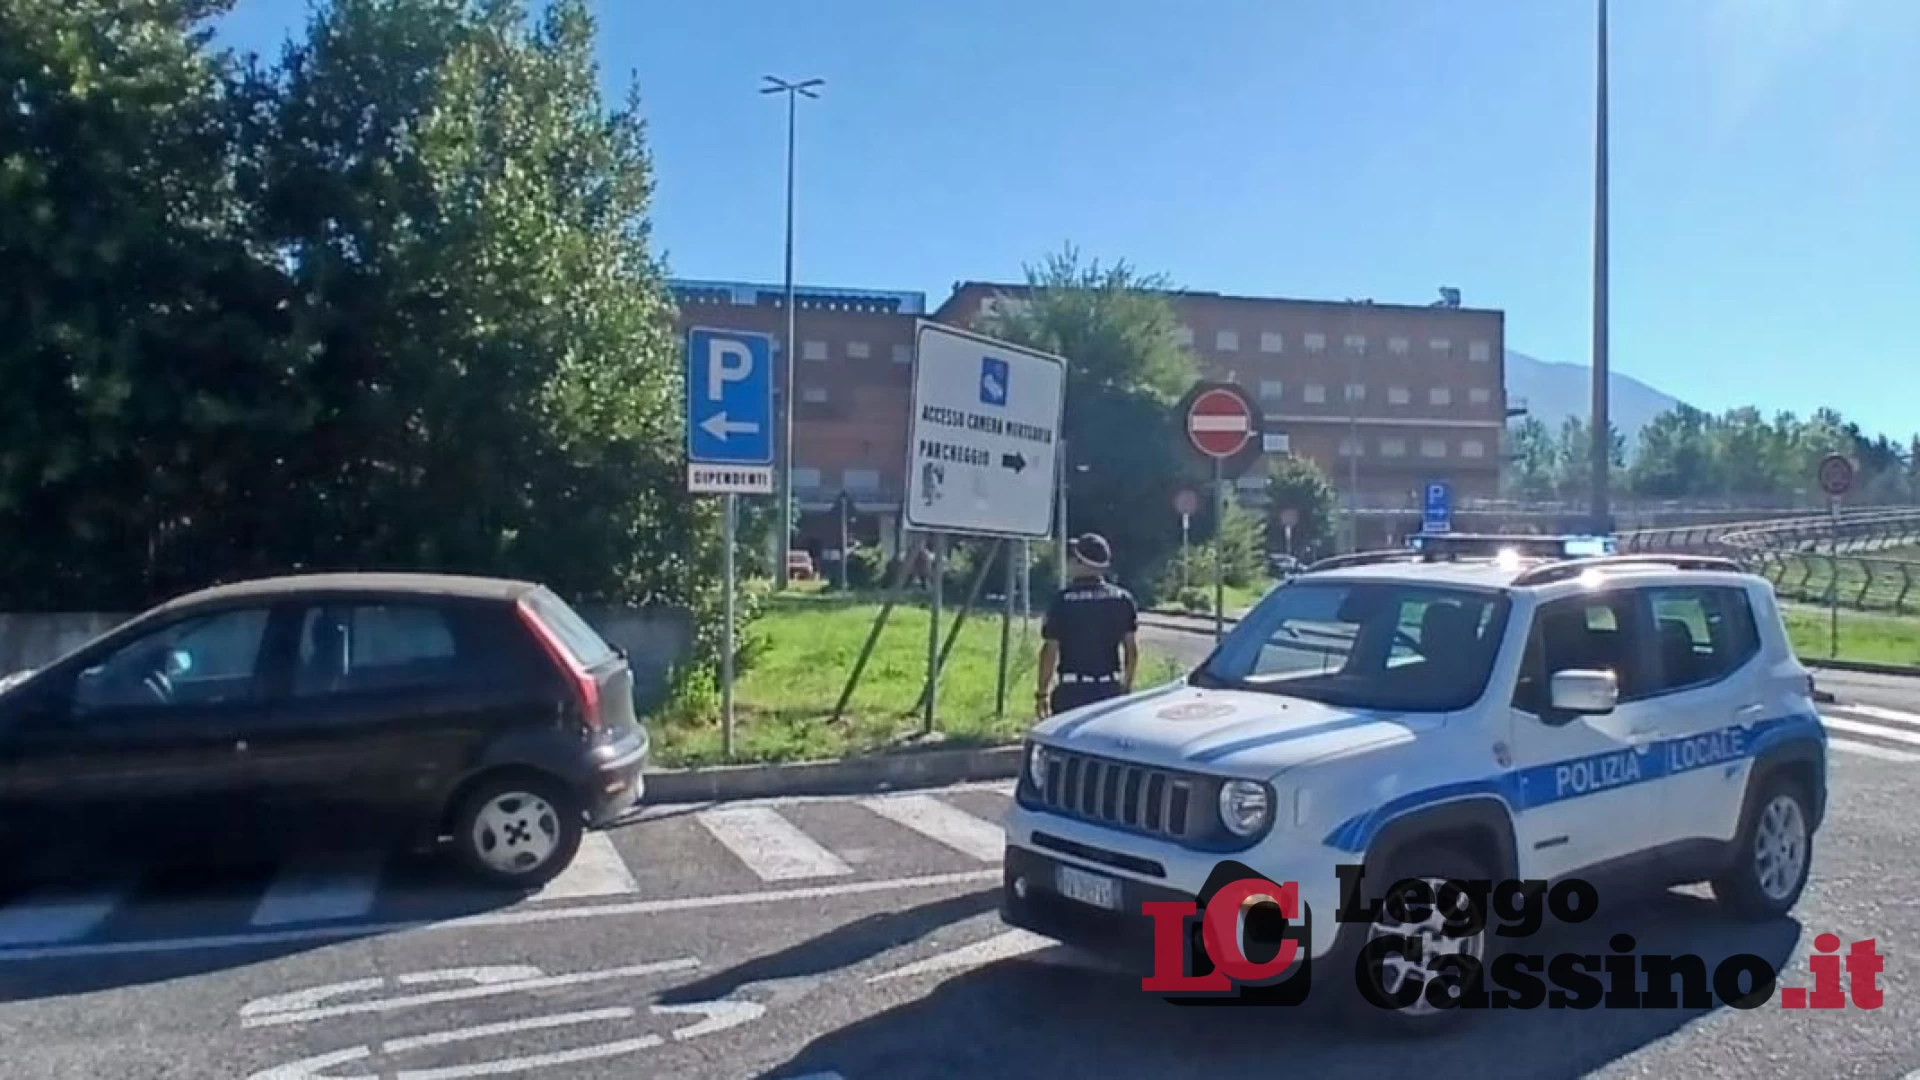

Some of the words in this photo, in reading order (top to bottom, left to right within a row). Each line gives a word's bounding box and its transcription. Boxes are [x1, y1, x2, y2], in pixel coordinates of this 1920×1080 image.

[708, 338, 753, 402] P
[922, 404, 964, 428] ACCESSO
[967, 412, 1002, 435] CAMERA
[920, 439, 990, 466] PARCHEGGIO
[1428, 484, 1444, 504] P
[1555, 752, 1641, 797] POLIZIA
[1670, 728, 1745, 771] LOCALE
